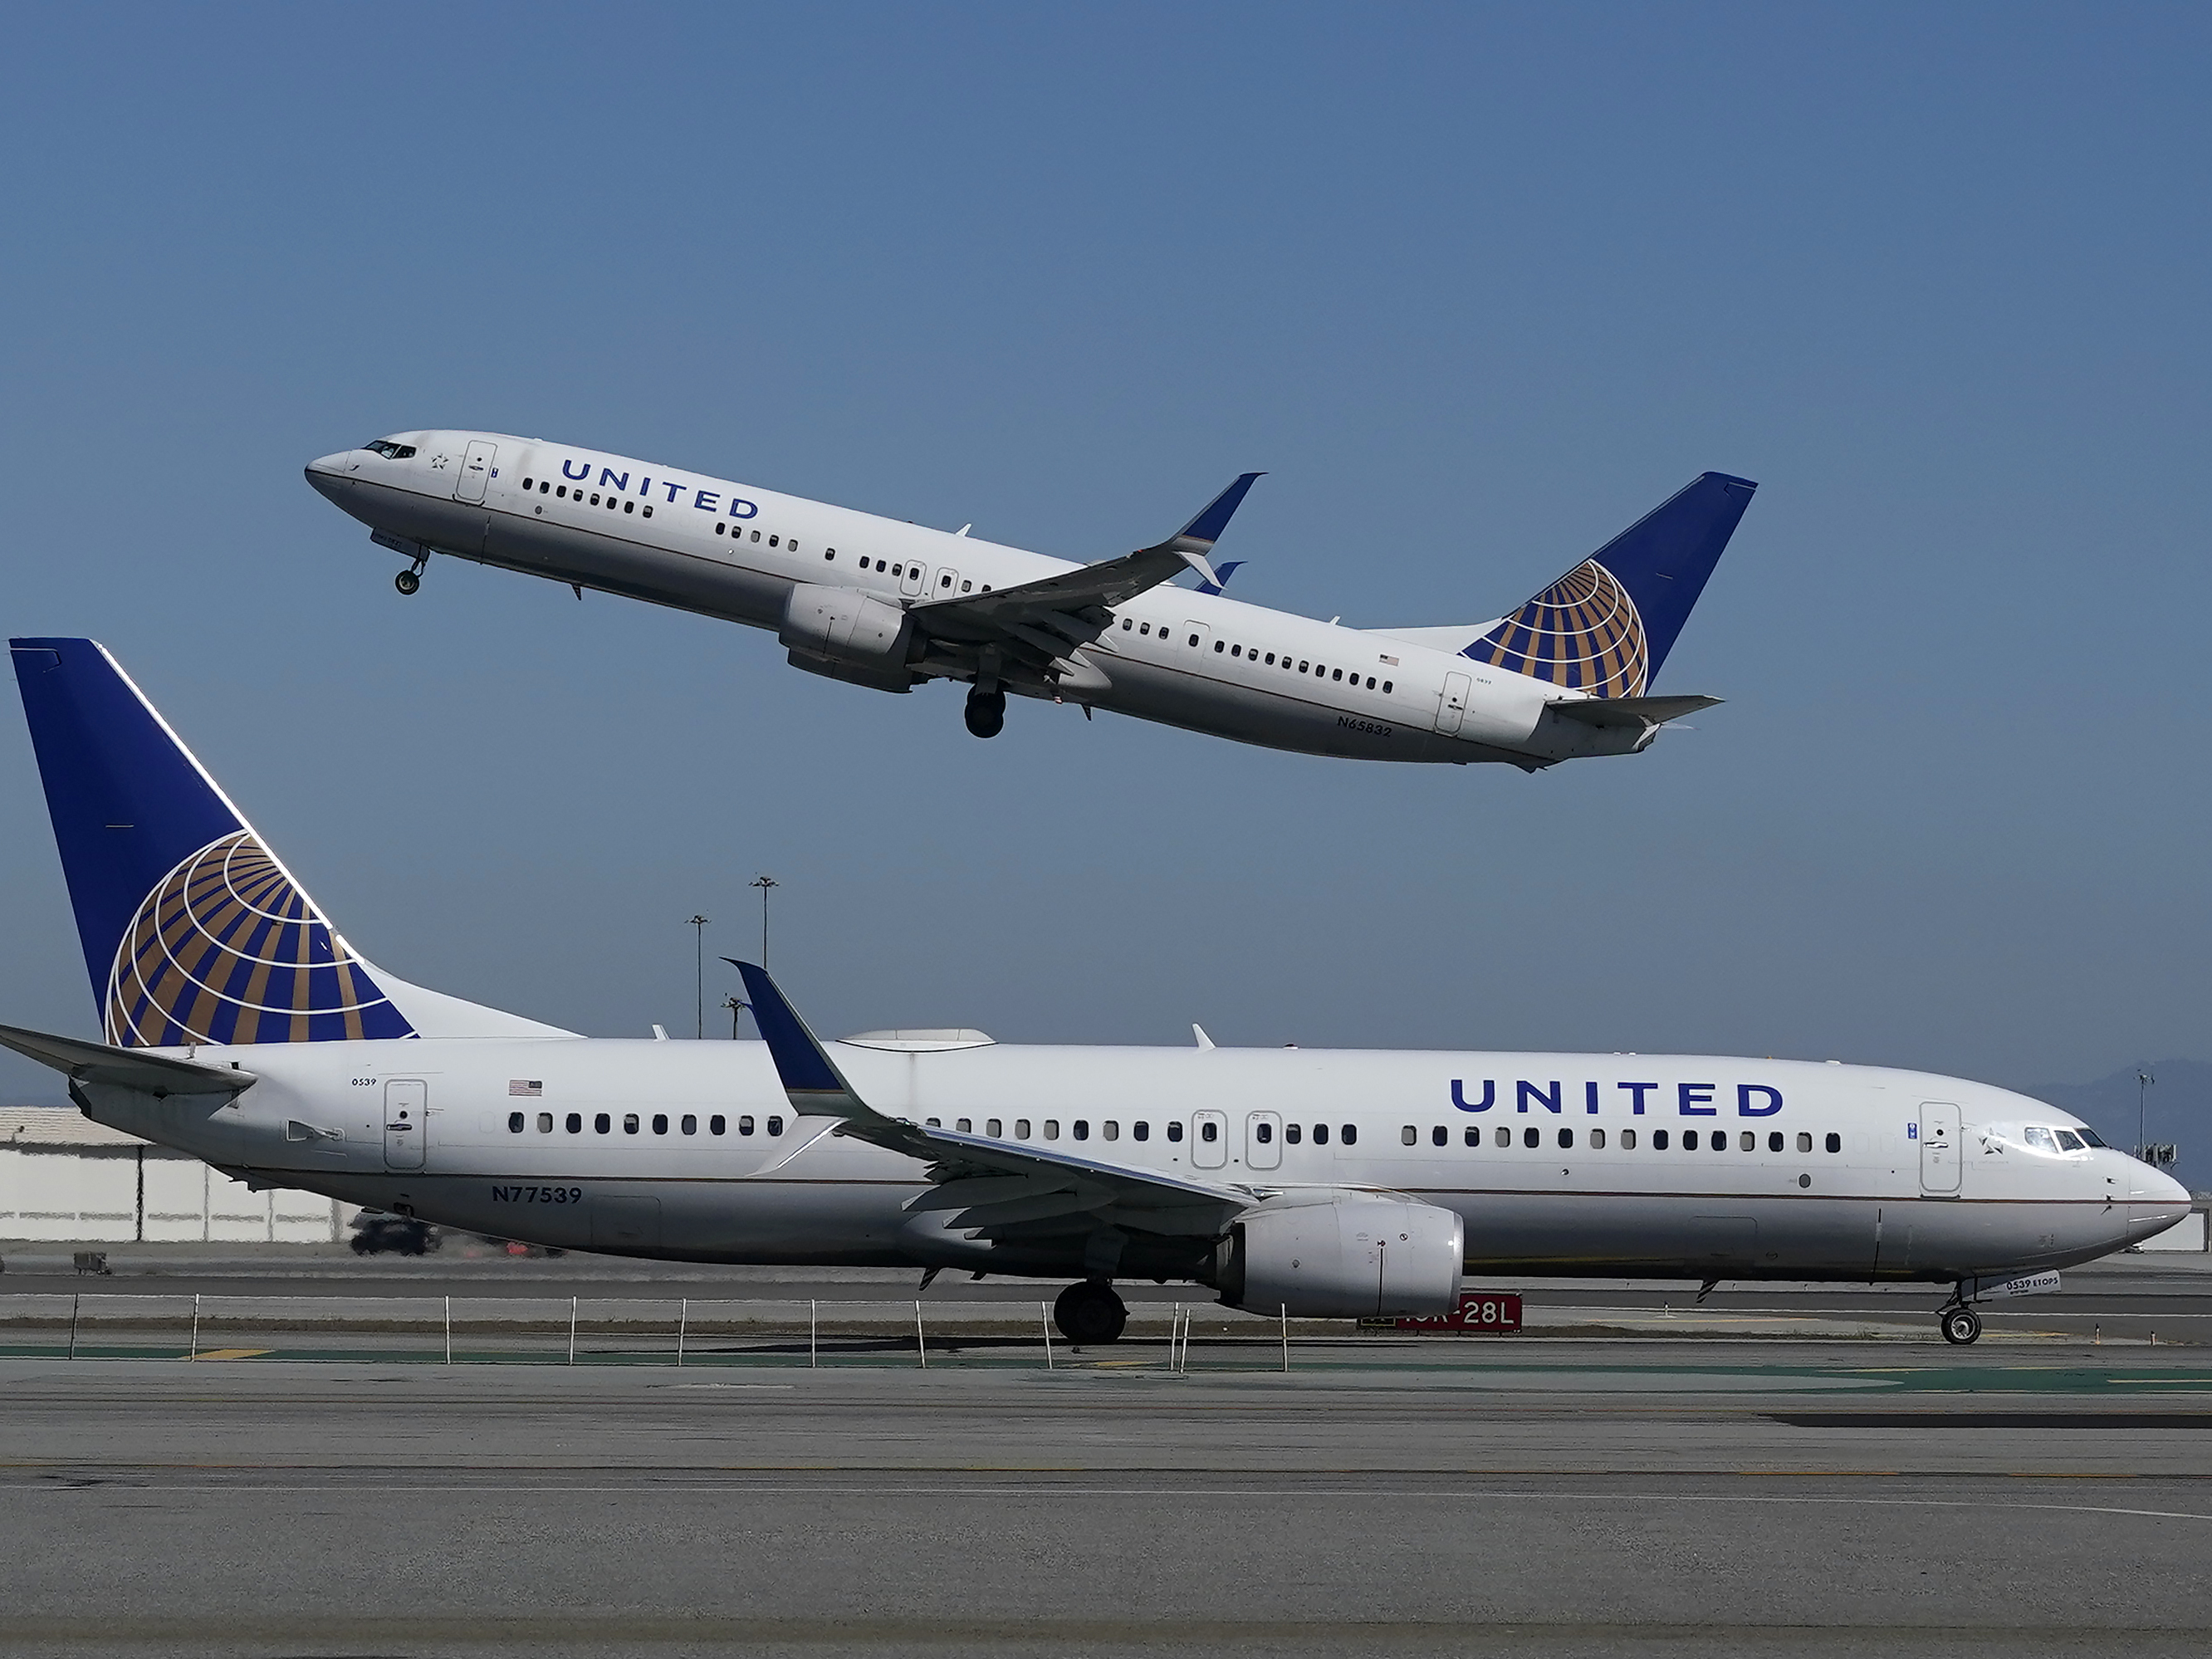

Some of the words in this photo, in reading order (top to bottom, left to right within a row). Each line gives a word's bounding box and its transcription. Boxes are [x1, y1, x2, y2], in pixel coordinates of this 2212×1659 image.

[562, 459, 759, 519] UNITED
[1337, 716, 1392, 737] N65832
[352, 1078, 377, 1086] 0539
[1451, 1079, 1784, 1117] UNITED
[492, 1186, 582, 1204] N77539
[2006, 1280, 2031, 1290] 0539
